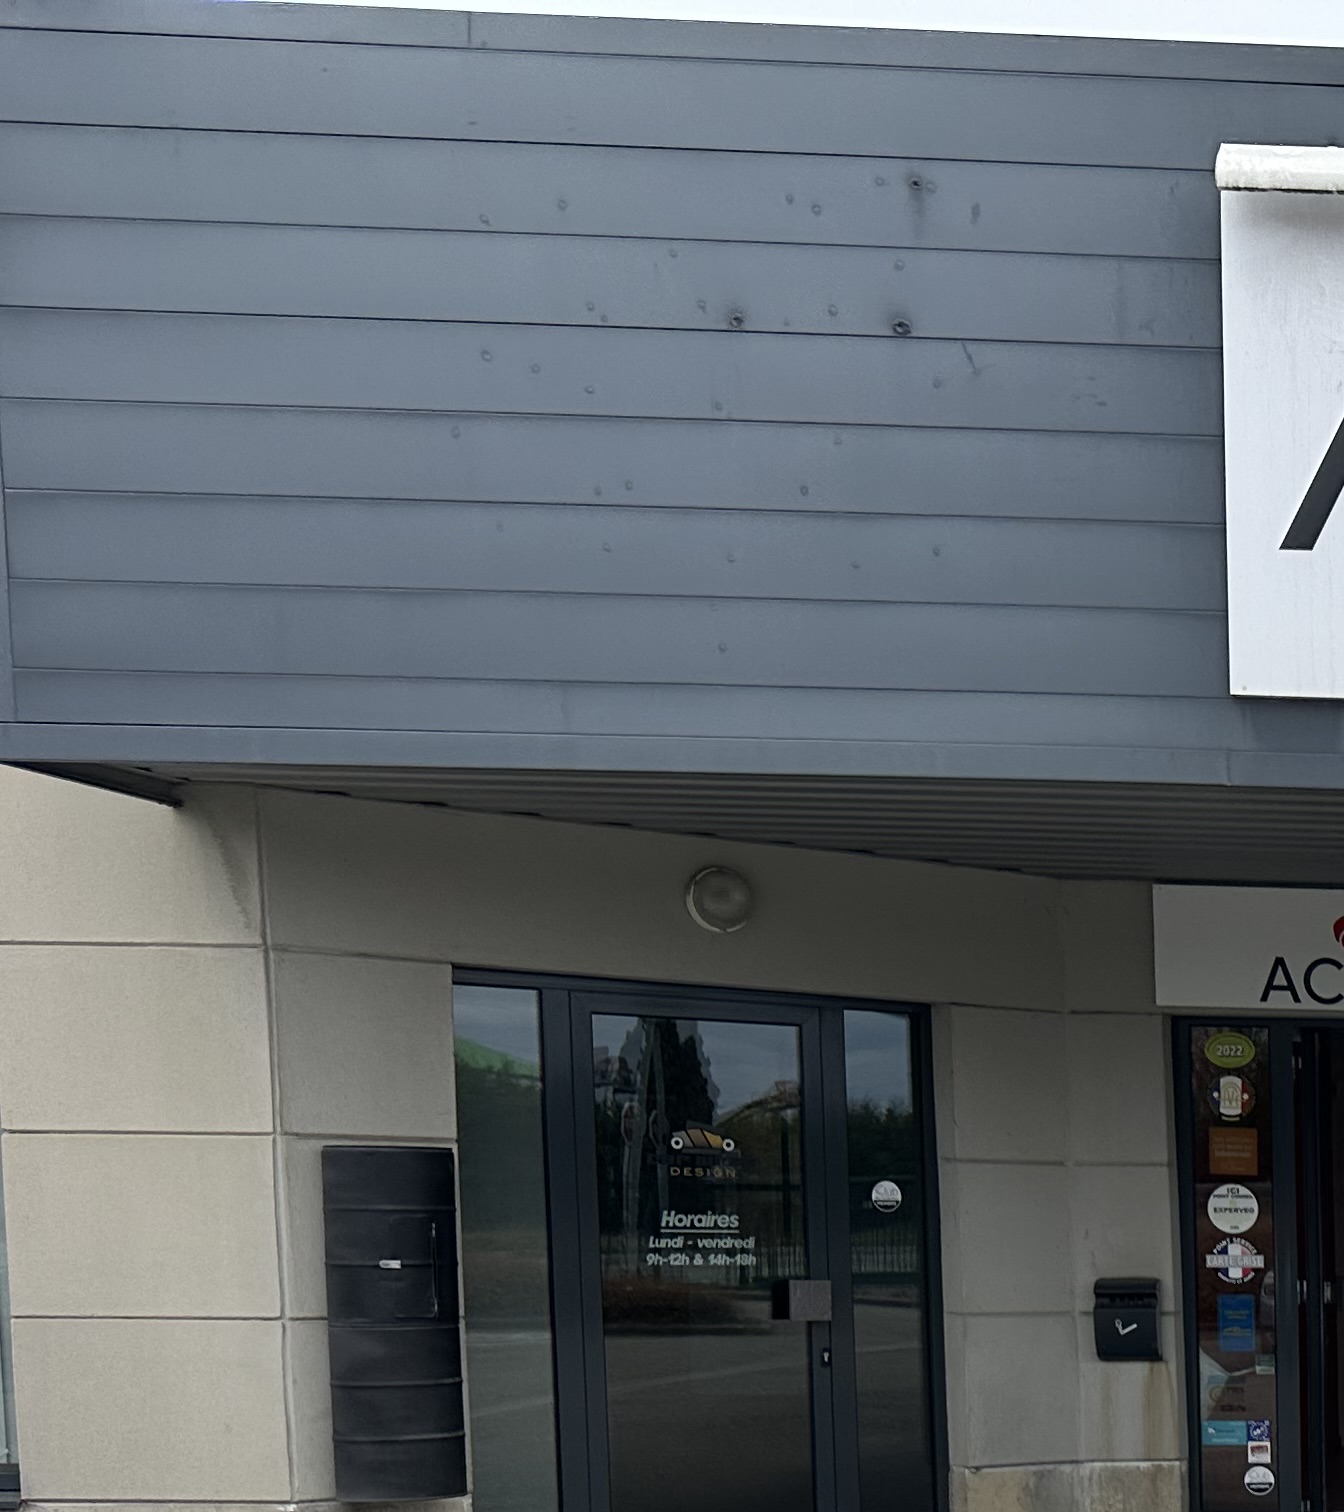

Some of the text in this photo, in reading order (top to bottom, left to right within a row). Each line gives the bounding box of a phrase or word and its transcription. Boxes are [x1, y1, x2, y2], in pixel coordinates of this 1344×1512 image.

[1216, 1044, 1244, 1057] 2022
[670, 1166, 737, 1179] DESIGN
[660, 1210, 740, 1228] Horaires
[648, 1235, 685, 1248] Lundi
[697, 1236, 757, 1249] vendredi
